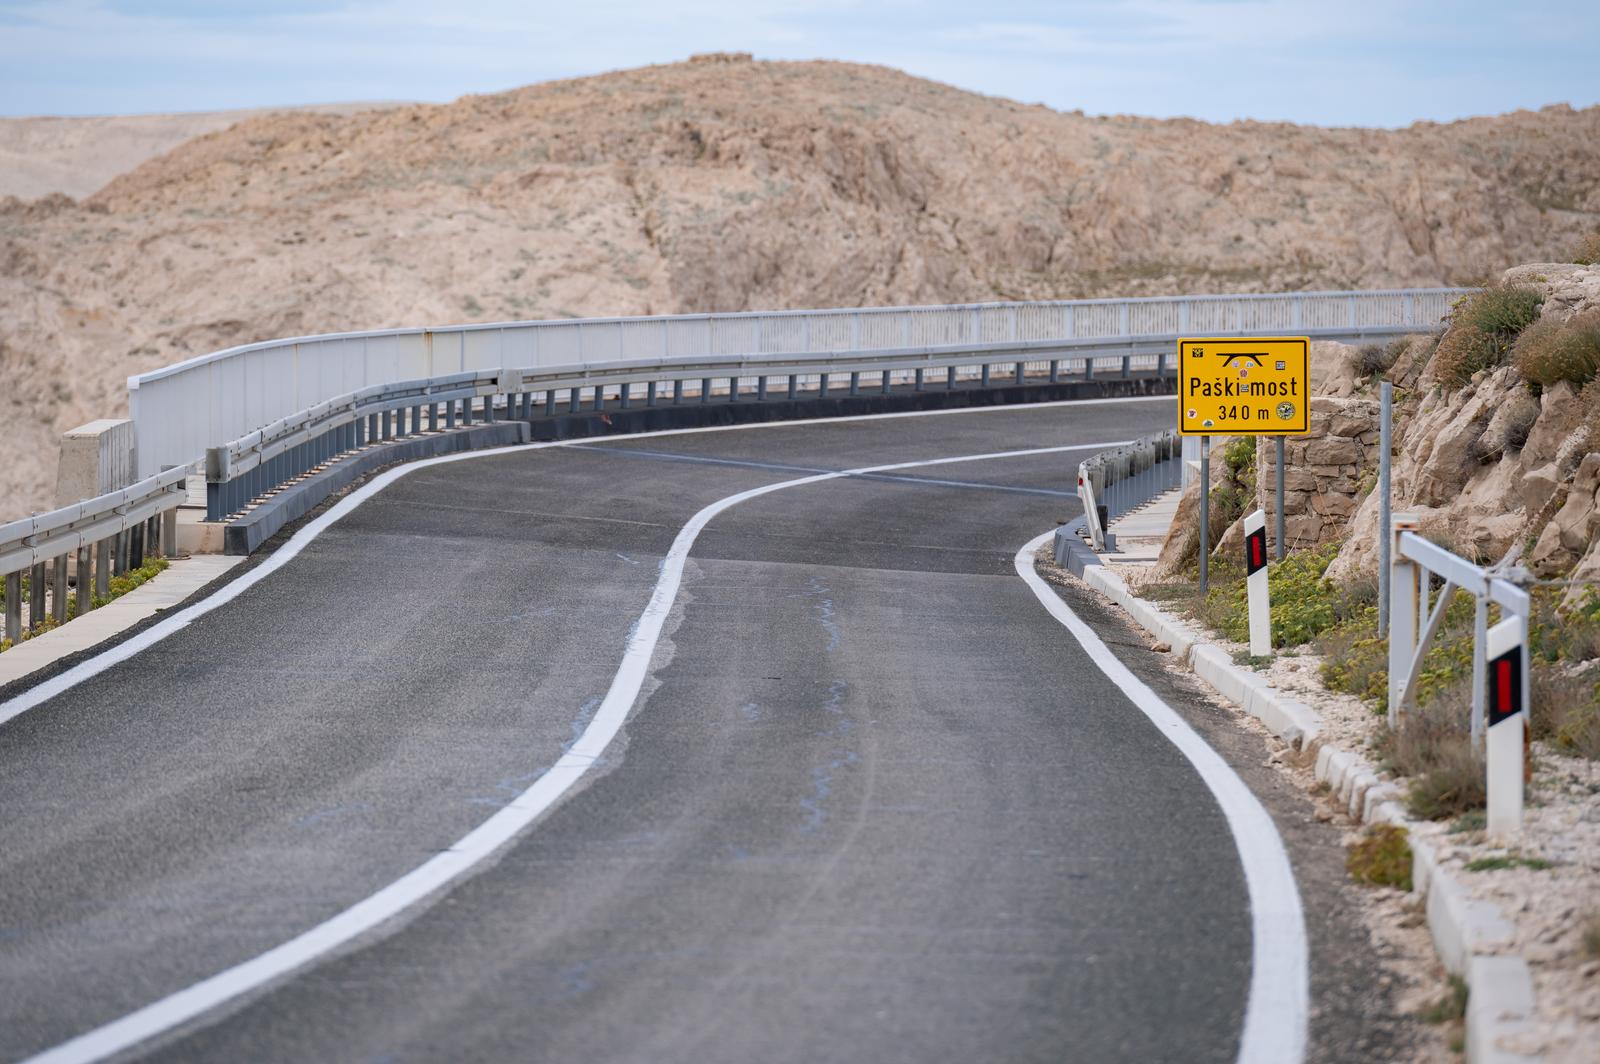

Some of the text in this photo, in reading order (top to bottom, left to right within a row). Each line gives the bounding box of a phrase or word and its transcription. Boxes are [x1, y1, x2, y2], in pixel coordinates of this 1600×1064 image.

[1190, 377, 1297, 397] Paški most
[1218, 405, 1250, 420] 340
[1258, 408, 1269, 420] m
